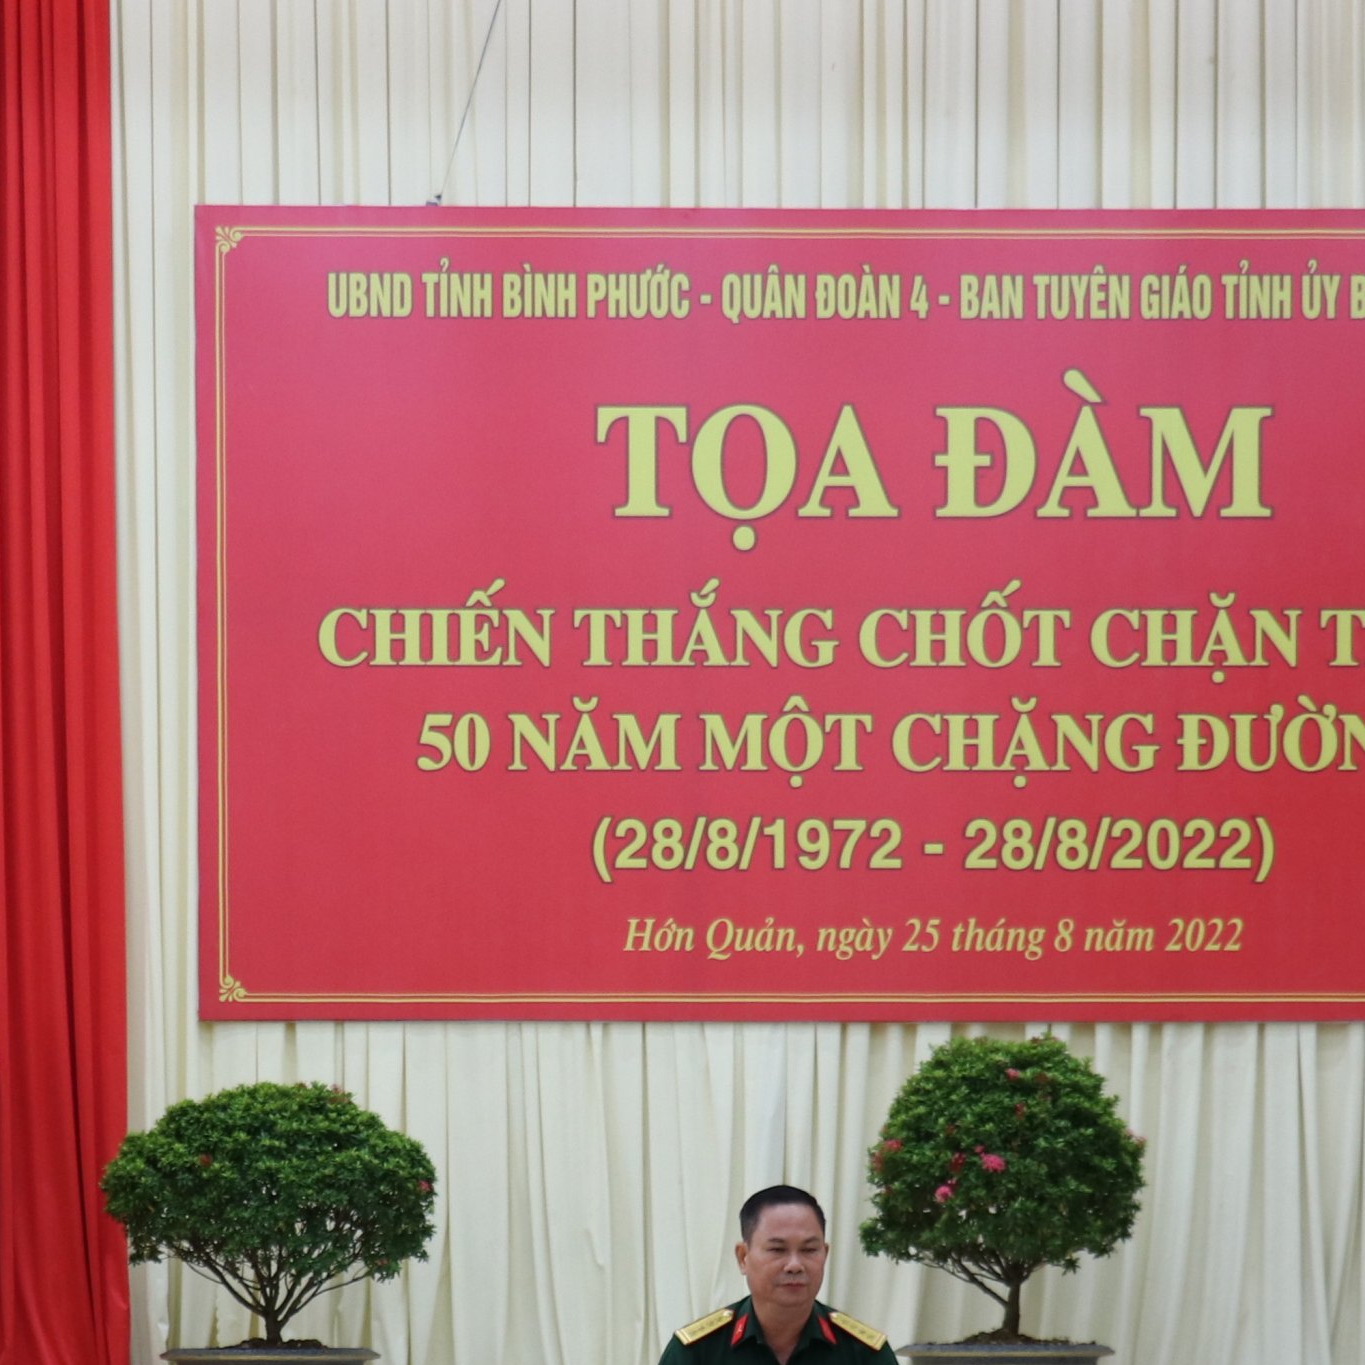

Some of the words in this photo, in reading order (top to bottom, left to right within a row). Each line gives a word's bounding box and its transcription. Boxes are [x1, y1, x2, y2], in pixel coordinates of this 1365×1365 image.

[327, 270, 414, 318] UBND
[420, 257, 494, 318] TỈNH
[501, 262, 578, 318] BÌNH
[585, 262, 691, 318] PHƯỚC
[698, 291, 714, 306] -
[721, 262, 808, 324] QUÂN
[814, 262, 902, 320] ĐOÀN
[908, 273, 930, 320] 4
[936, 292, 952, 307] -
[959, 273, 1025, 320] BAN
[1033, 264, 1132, 320] TUYÊN
[1139, 263, 1214, 320] GIÁO
[1221, 258, 1293, 320] TỈNH
[1300, 258, 1342, 320] ỦY
[595, 402, 901, 552] TỌA
[933, 367, 1275, 519] ĐÀM
[316, 576, 555, 669] CHIẾN
[571, 575, 840, 669] THẮNG
[857, 577, 1074, 670] CHỐT
[1088, 588, 1303, 683] CHẶN
[415, 710, 493, 773] 50
[507, 694, 682, 772] NĂM
[699, 692, 875, 791] MỘT
[890, 694, 1161, 791] CHẶNG
[592, 813, 904, 883] (28/8/1972
[923, 841, 945, 855] -
[964, 814, 1277, 883] 28/8/2022)
[622, 917, 695, 953] Hớn
[704, 915, 806, 962] Quản,
[815, 917, 894, 962] ngày
[901, 917, 941, 954] 25
[950, 915, 1046, 962] tháng
[1052, 917, 1076, 954] 8
[1083, 917, 1156, 954] năm
[1164, 917, 1245, 954] 2022
